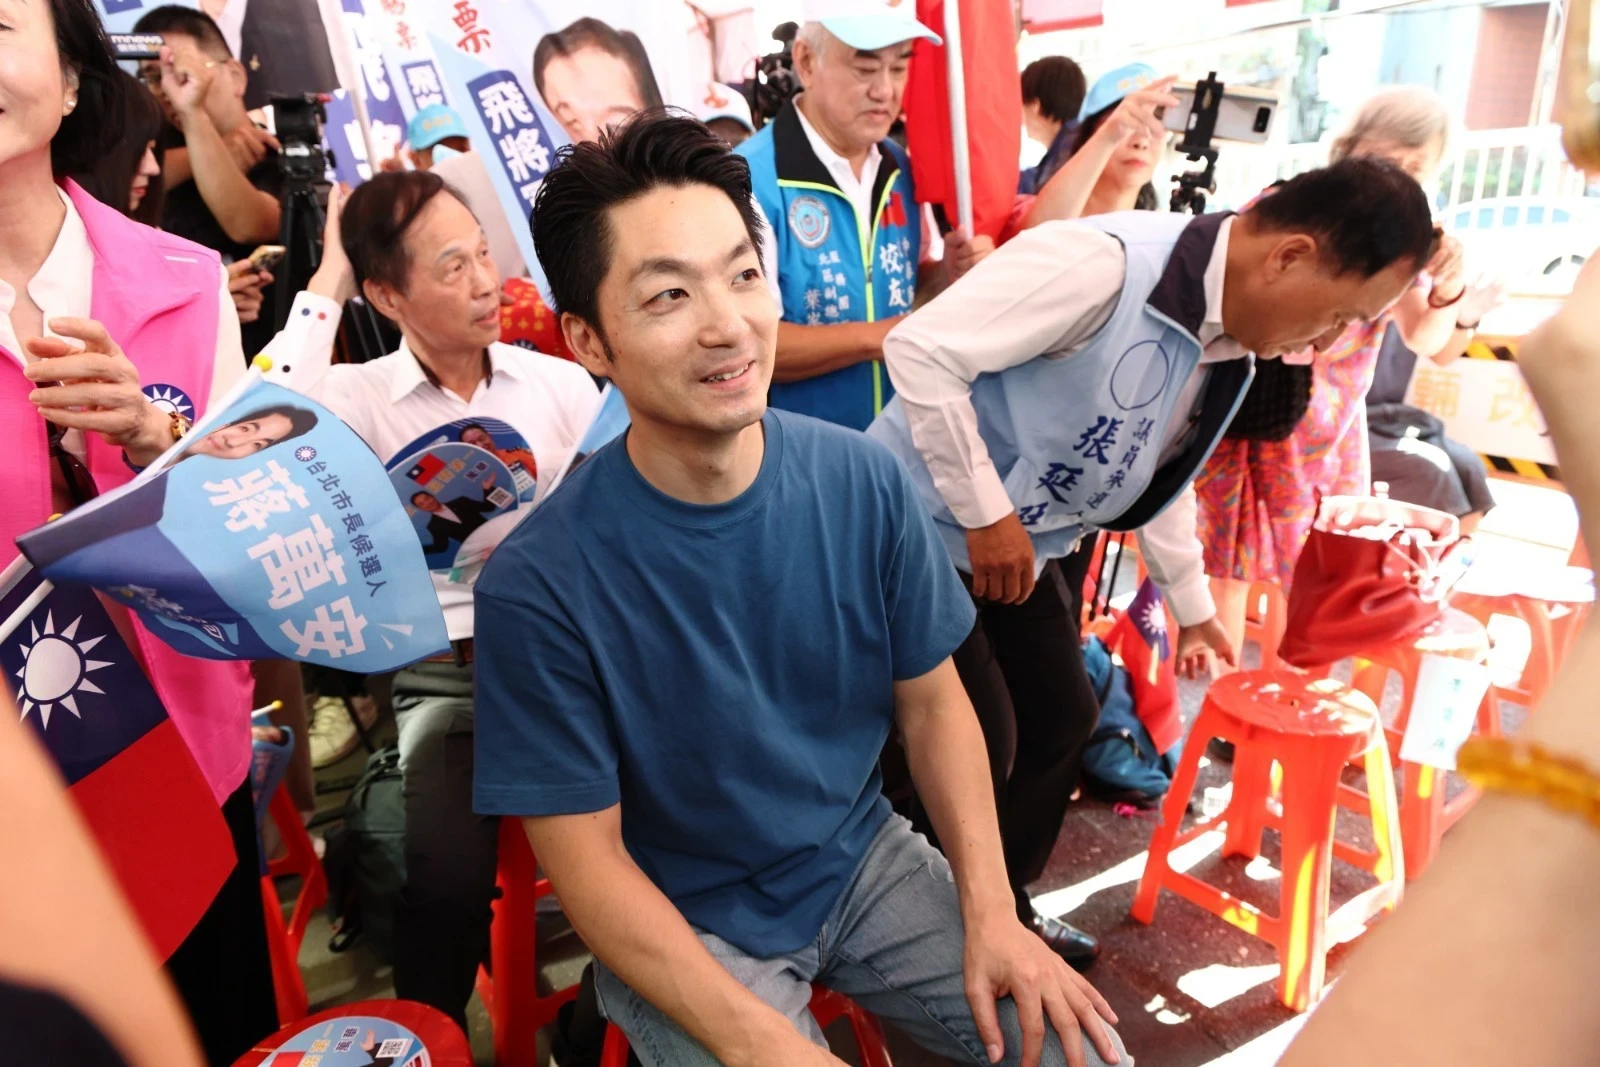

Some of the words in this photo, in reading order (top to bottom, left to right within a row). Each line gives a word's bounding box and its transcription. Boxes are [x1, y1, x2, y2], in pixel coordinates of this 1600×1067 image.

[452, 0, 491, 53] 票
[203, 459, 369, 659] 蔣萬安
[305, 460, 387, 598] 台北市長候選人
